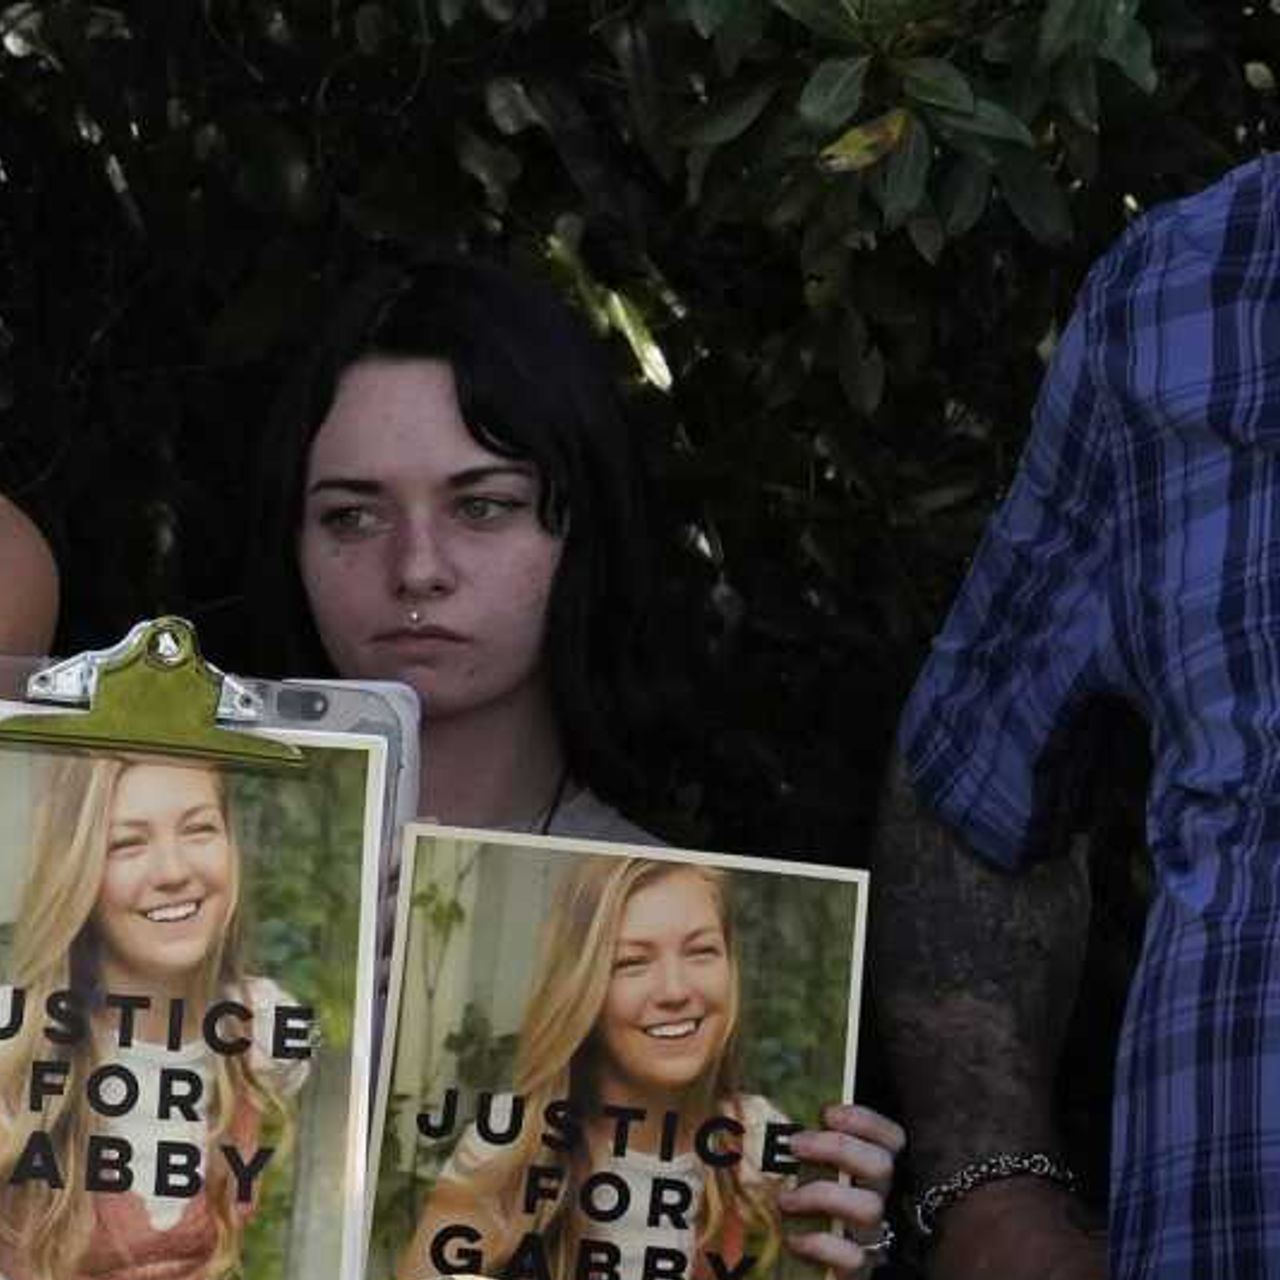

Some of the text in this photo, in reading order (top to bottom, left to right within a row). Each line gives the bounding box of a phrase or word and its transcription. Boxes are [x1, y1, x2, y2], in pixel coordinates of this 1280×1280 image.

[30, 1059, 206, 1122] FOR
[416, 1087, 802, 1176] JUSTICE
[522, 1165, 692, 1231] FOR
